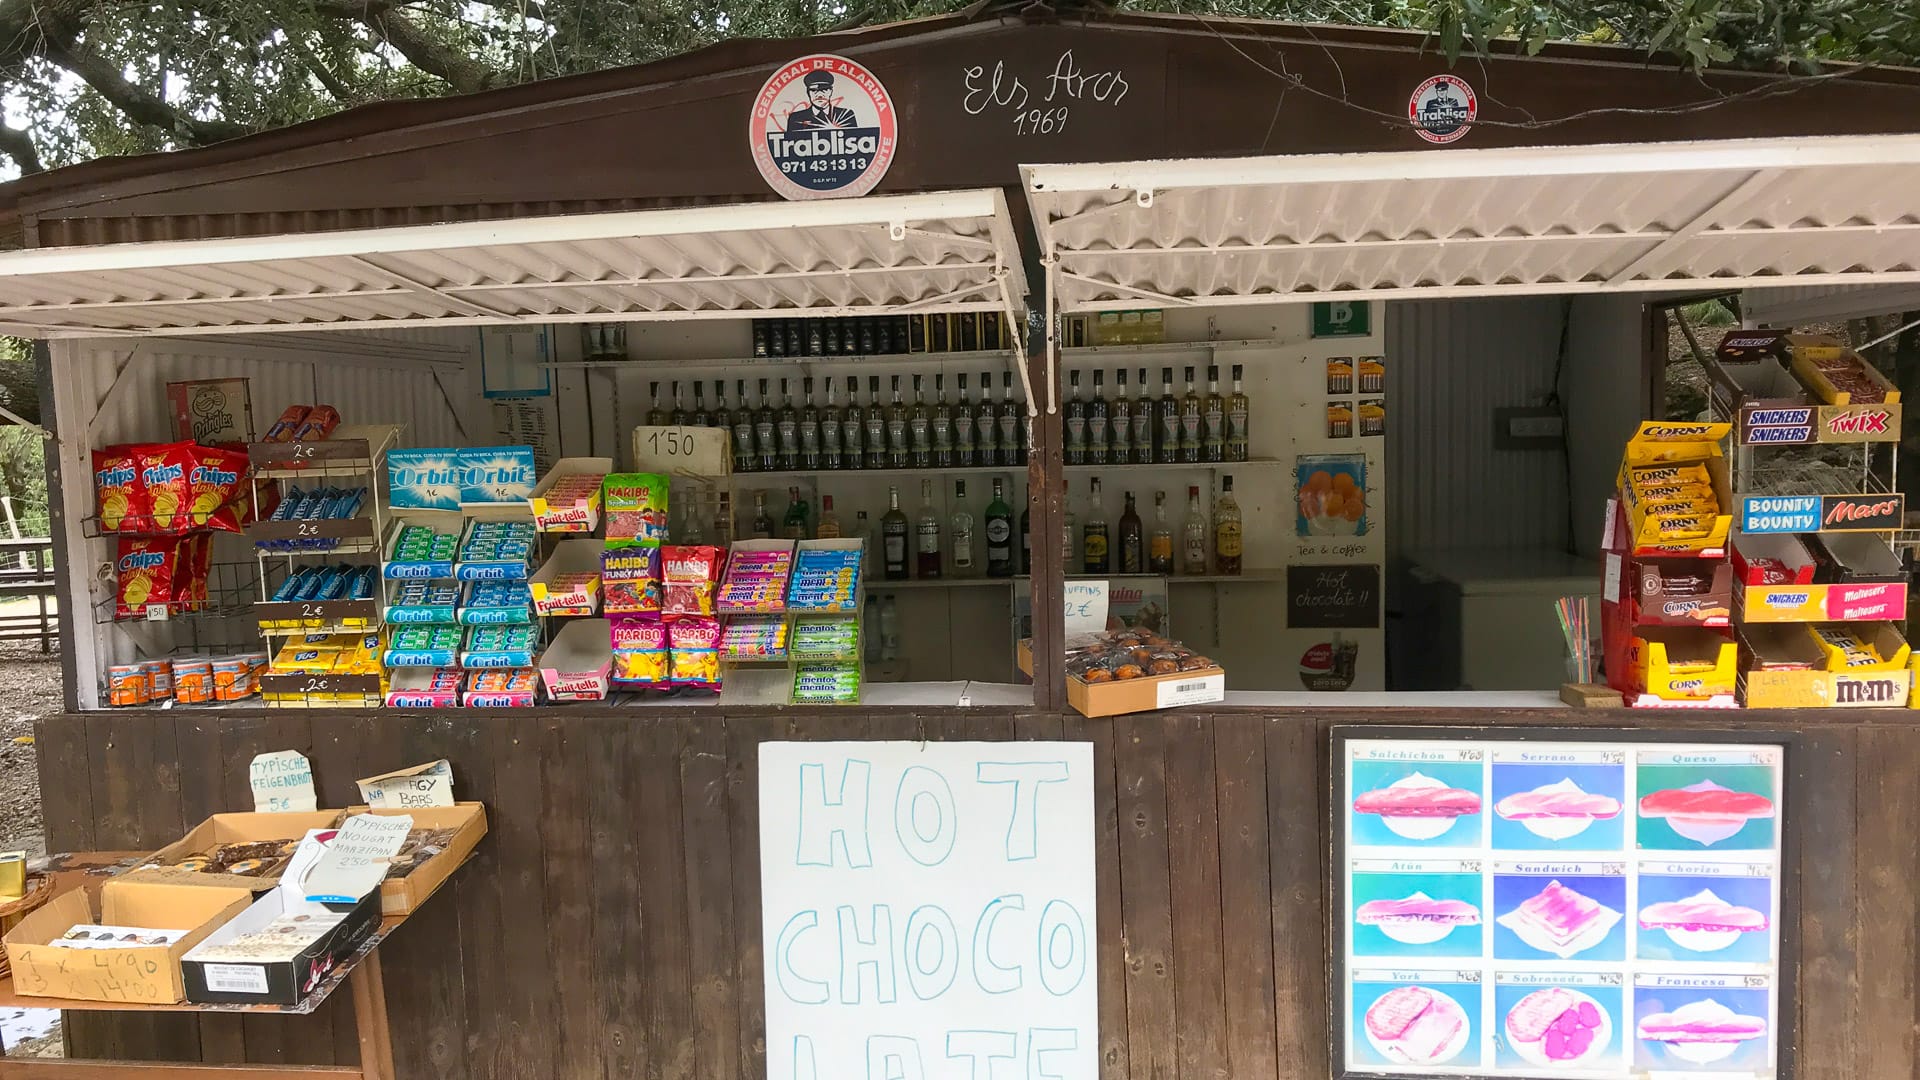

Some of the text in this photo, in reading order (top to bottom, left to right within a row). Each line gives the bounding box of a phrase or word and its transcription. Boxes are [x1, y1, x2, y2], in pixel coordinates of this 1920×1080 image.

[963, 49, 1129, 114] Els Arcs
[757, 59, 888, 119] CENTRAL DE ALARMA
[768, 130, 877, 158] Trablisa
[781, 159, 868, 174] 971 43 13 13
[1749, 410, 1809, 425] SNICKERS
[193, 409, 233, 446] Pringles
[1642, 425, 1713, 436] CORNY
[1749, 427, 1809, 442] SNICKERS
[190, 466, 237, 488] Chips
[394, 466, 459, 488] Orbit
[464, 465, 531, 487] Orbit
[1633, 467, 1680, 483] CORNY
[607, 487, 650, 498] HARIBO
[1644, 501, 1693, 516] CORNY
[1749, 498, 1815, 513] BOUNTY
[1825, 499, 1897, 525] Mars
[1659, 517, 1699, 529] ORNY
[1748, 515, 1814, 530] BOUNTY
[118, 550, 165, 572] Chips
[605, 556, 650, 570] HARIBO
[390, 565, 432, 578] Orbit
[463, 567, 505, 580] Orbit
[605, 570, 632, 579] FUNKY
[1064, 586, 1102, 597] UFFINS
[1844, 584, 1888, 602] Maltesers
[1765, 593, 1809, 605] SNICKERS
[1663, 600, 1702, 614] CORNY
[1844, 604, 1888, 620] Maltesers
[392, 610, 434, 623] Orbit
[468, 610, 508, 624] Orbit
[614, 628, 660, 642] HARIBO
[295, 650, 318, 661] TUC
[394, 654, 433, 666] Orbit
[471, 655, 511, 668] Orbit
[1668, 679, 1704, 690] CORNY
[394, 696, 435, 708] Orbit
[472, 696, 512, 708] Orbit
[1520, 752, 1576, 762] Serrano
[1672, 754, 1717, 764] Queso
[399, 791, 433, 806] BARS
[796, 758, 1070, 869] HOT
[341, 830, 396, 844] NOUGAT
[333, 842, 393, 856] MARZIPAN
[1515, 864, 1583, 874] Sandwich
[1666, 864, 1720, 874] Chorizo
[775, 894, 1087, 1005] CHOCO
[1657, 976, 1726, 986] Francesa
